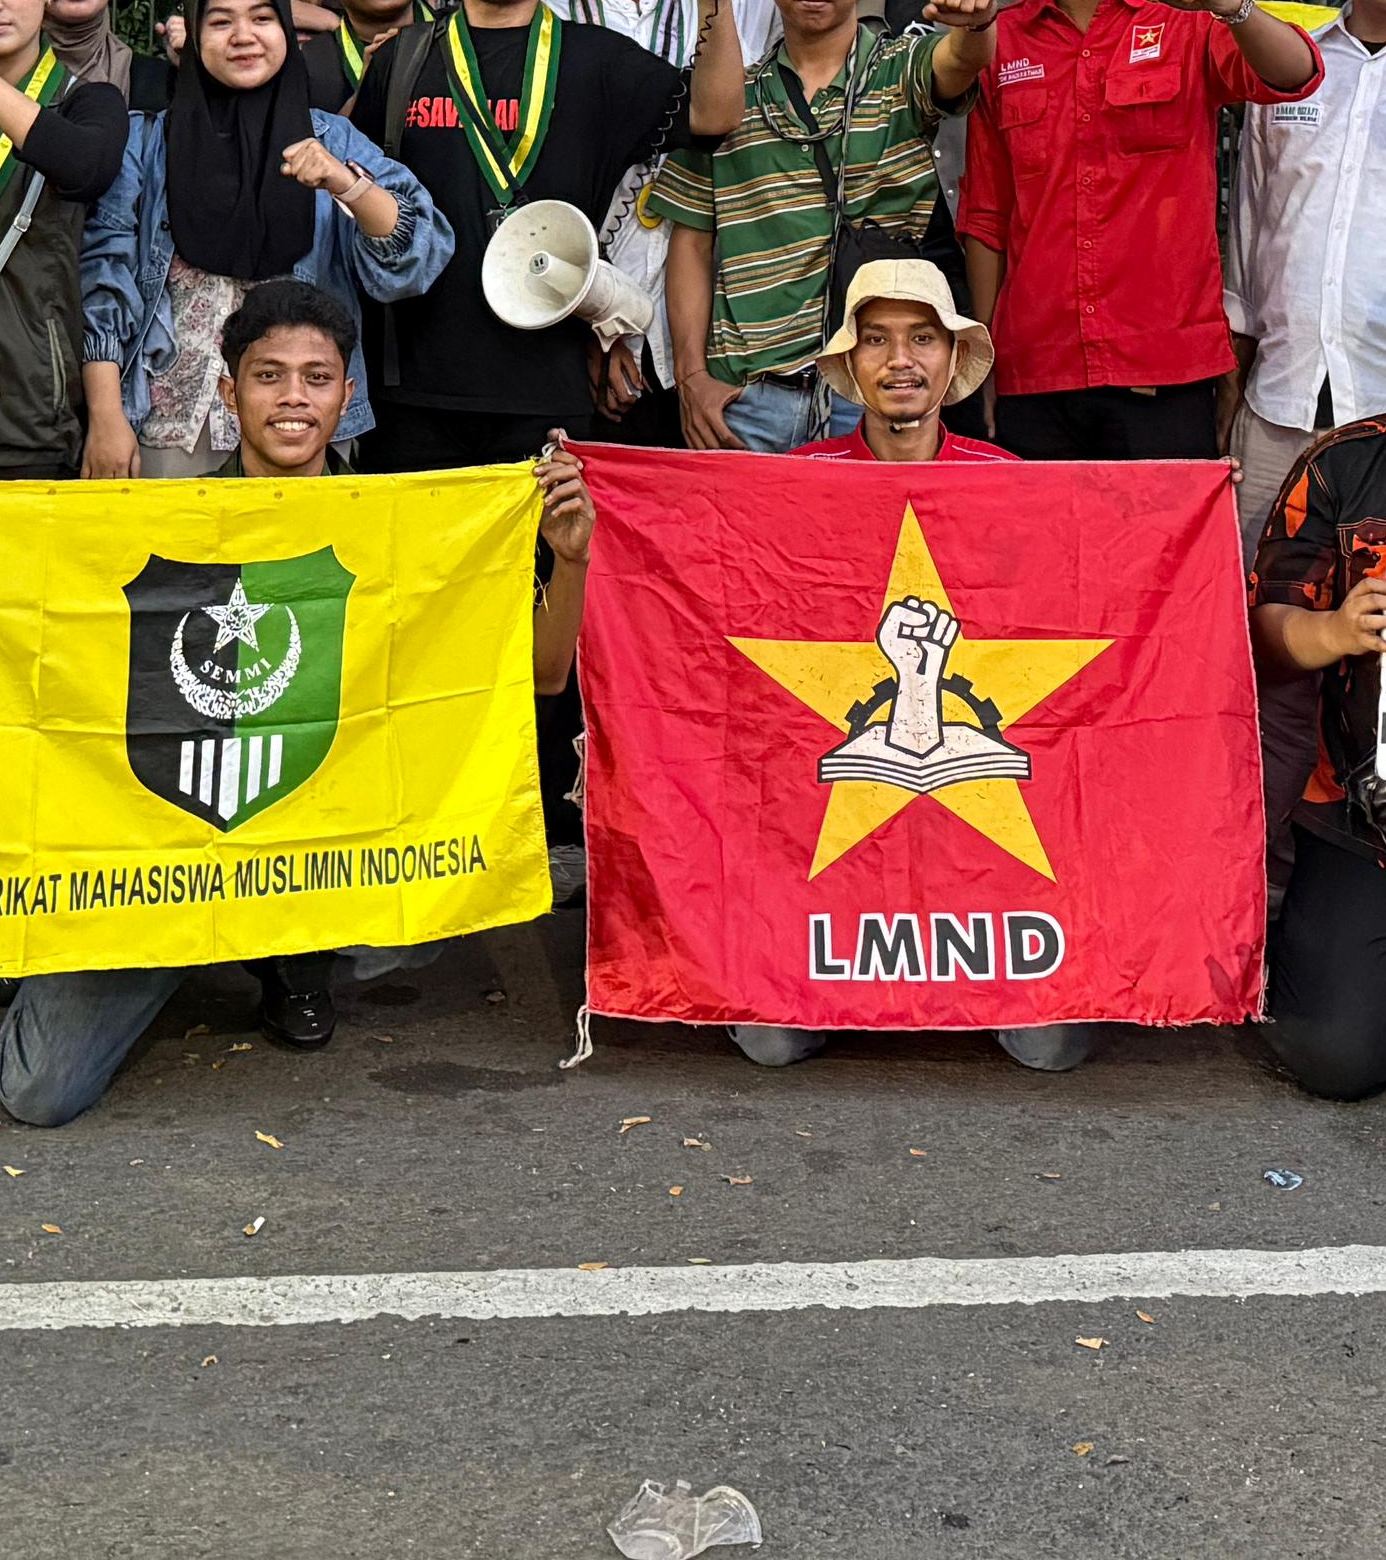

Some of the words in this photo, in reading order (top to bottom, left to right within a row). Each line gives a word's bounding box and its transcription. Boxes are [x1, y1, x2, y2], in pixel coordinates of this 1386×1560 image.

[199, 657, 273, 684] SEMMI
[69, 861, 228, 913] MAHASISWA
[234, 848, 353, 898] MUSLIMIN
[359, 833, 488, 888] INDONESIA
[808, 910, 1067, 983] LMND
